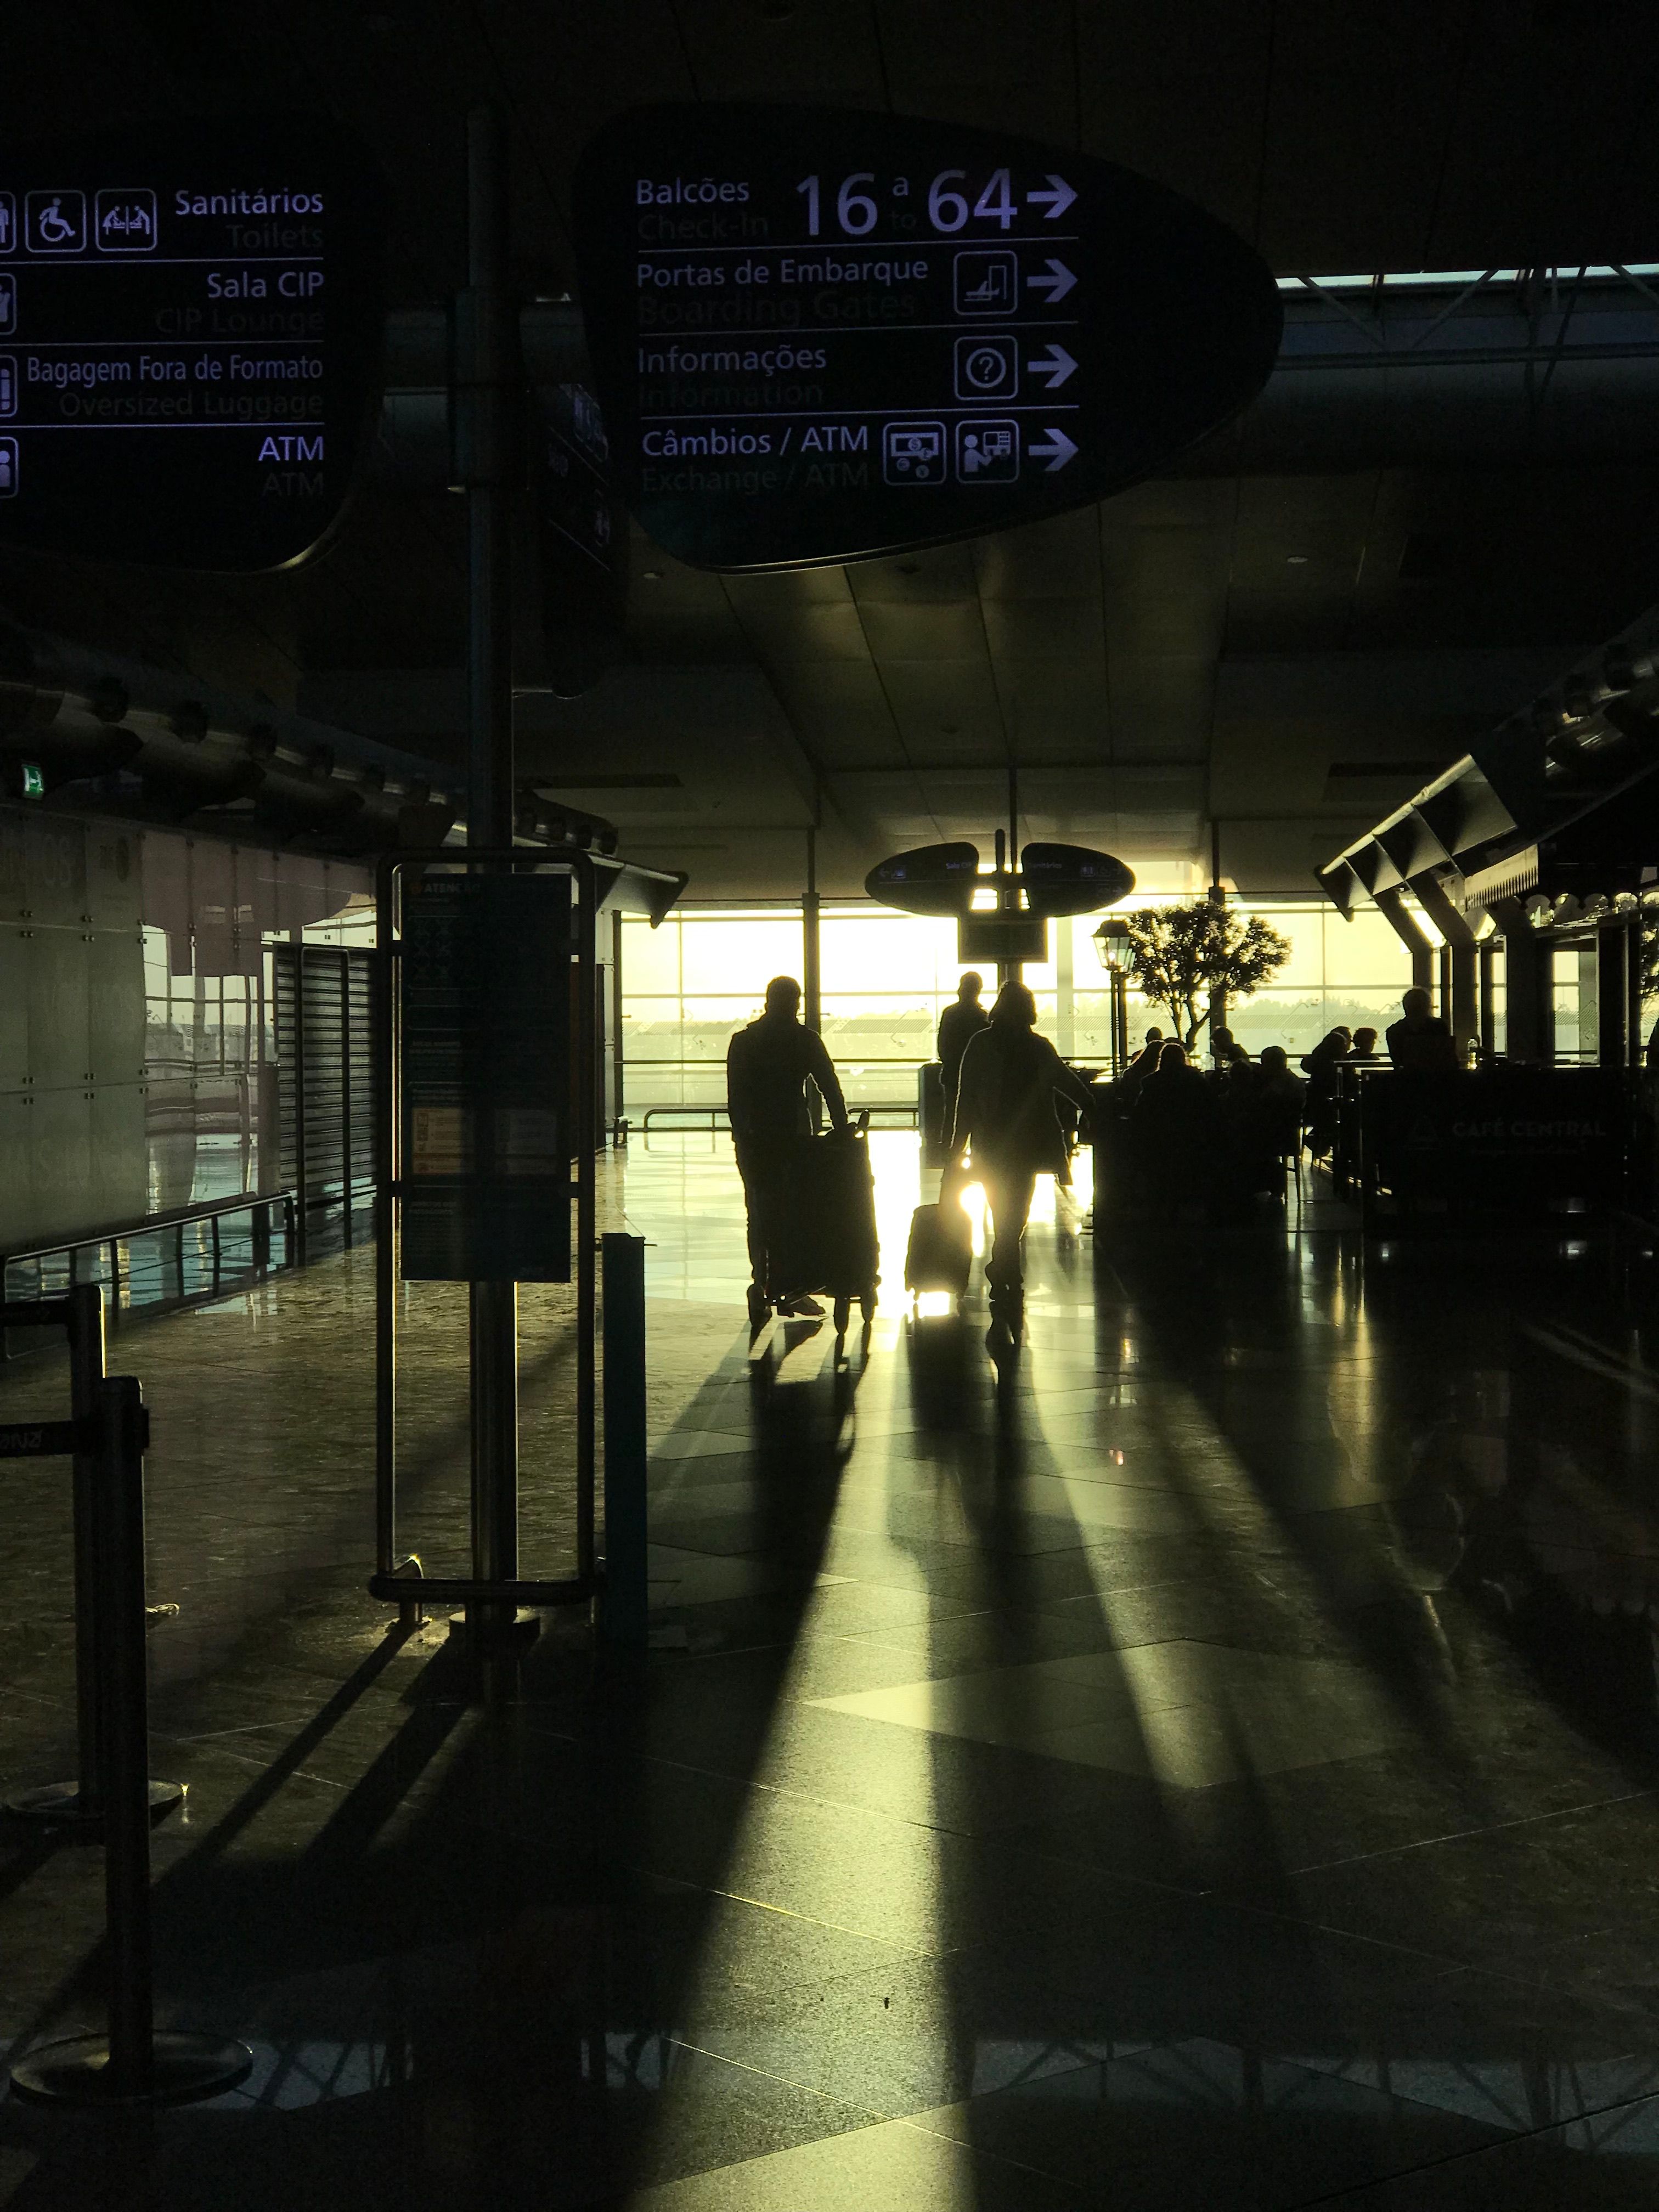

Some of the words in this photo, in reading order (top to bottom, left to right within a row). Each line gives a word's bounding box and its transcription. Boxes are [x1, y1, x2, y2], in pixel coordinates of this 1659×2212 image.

[175, 187, 324, 216] Sanitários
[636, 177, 750, 206] Balcões
[795, 172, 878, 236] 16
[892, 176, 910, 198] a
[927, 167, 1019, 233] 64
[225, 224, 324, 249] Toilets
[206, 270, 267, 298] Sala
[277, 270, 325, 297] CIP
[636, 263, 726, 289] Portas
[734, 259, 770, 285] de
[780, 256, 929, 292] Embarque
[155, 306, 203, 334] CIP
[211, 307, 325, 337] Lounge
[638, 295, 801, 330] Boarding
[812, 289, 916, 320] Gates
[27, 356, 132, 388] Bagagem
[139, 355, 187, 381] Fora
[194, 353, 223, 381] de
[229, 354, 324, 380] Formato
[638, 344, 827, 377] Informações
[59, 390, 194, 417] Oversized
[204, 391, 325, 420] Luggage
[639, 380, 825, 410] Information
[258, 436, 324, 462] ATM
[642, 427, 772, 457] Câmbios
[779, 426, 793, 456] /
[800, 425, 868, 453] ATM
[262, 471, 324, 498] ATM
[642, 465, 780, 495] Exchange
[807, 461, 869, 488] ATM
[1452, 1117, 1505, 1137] CAFÉ
[1510, 1120, 1607, 1137] CENTRAL
